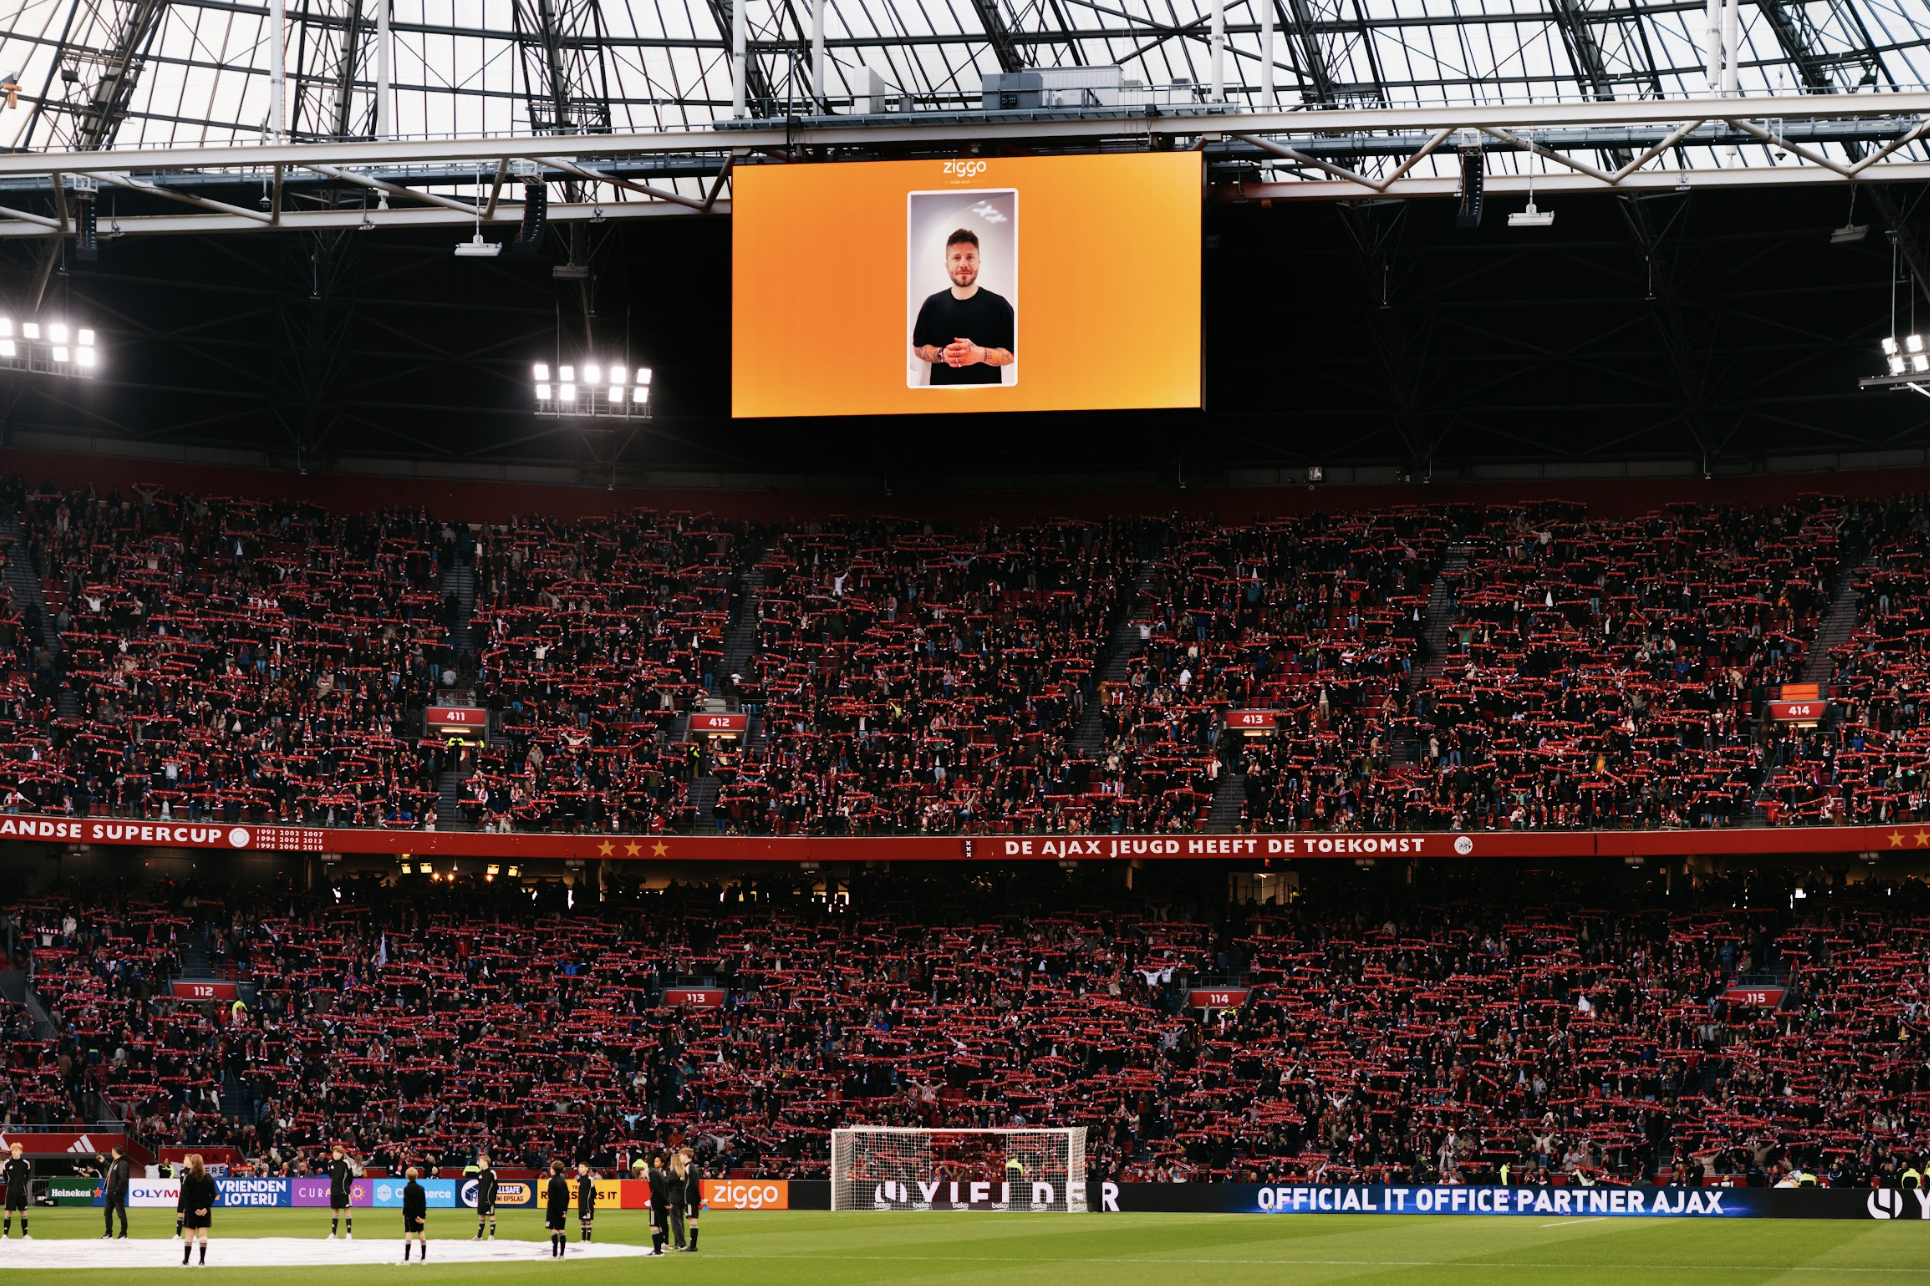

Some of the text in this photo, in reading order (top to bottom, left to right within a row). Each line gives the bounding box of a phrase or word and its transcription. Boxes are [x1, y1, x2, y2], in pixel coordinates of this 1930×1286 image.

[943, 158, 987, 177] ziggo
[1789, 706, 1810, 715] 414
[447, 712, 465, 720] 411
[1243, 715, 1263, 724] 413
[709, 718, 730, 727] 412
[0, 820, 222, 843] ANDSE SUPERCUP
[1005, 838, 1425, 858] DE AJAX JEUGD HEEFT DE TOEKOMST
[194, 986, 213, 996] 112
[687, 993, 705, 1003] 113
[1210, 994, 1229, 1003] 114
[1747, 993, 1766, 1003] 115
[215, 1180, 287, 1193] VRIENDEN
[51, 1188, 91, 1197] Heineken
[132, 1189, 178, 1198] OLYM
[607, 1191, 617, 1200] IT
[714, 1181, 779, 1209] ziggo
[225, 1193, 278, 1206] LOTERIJ
[1258, 1187, 1724, 1214] OFFICIAL IT OFFICE PARTNER AJAX
